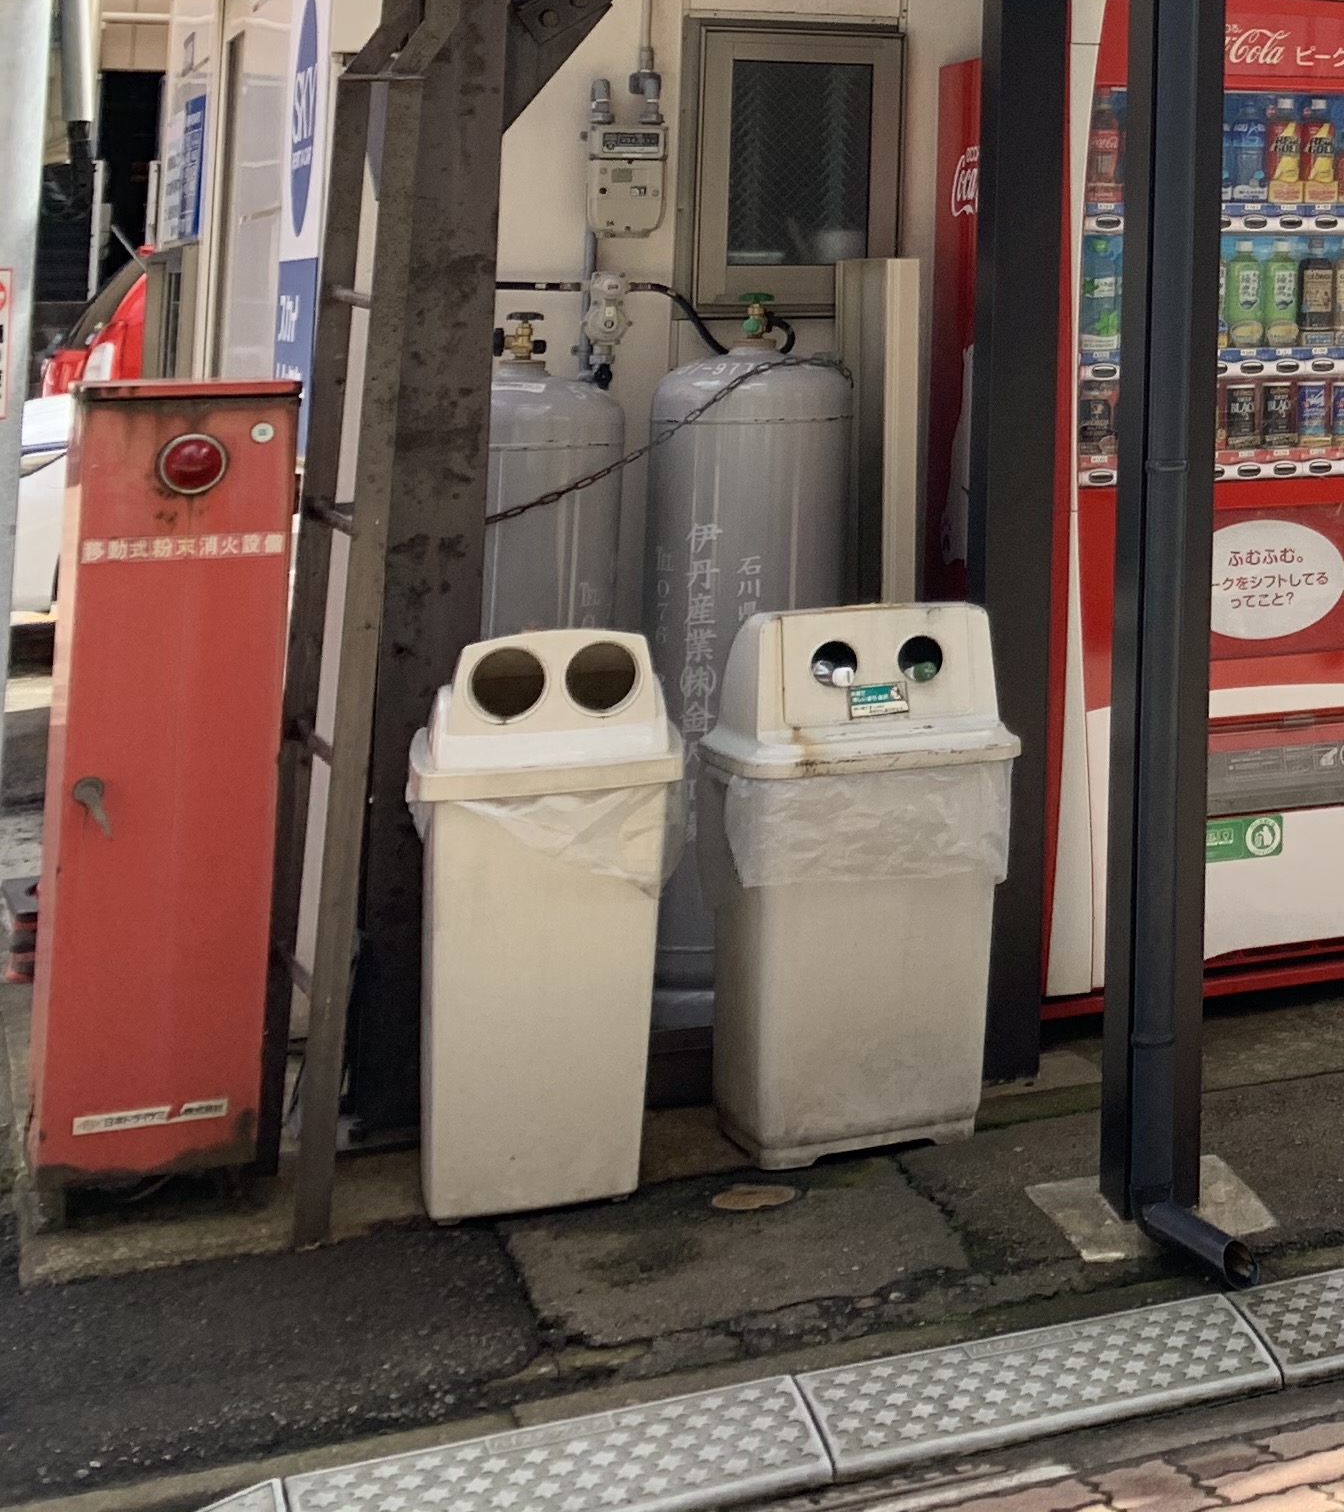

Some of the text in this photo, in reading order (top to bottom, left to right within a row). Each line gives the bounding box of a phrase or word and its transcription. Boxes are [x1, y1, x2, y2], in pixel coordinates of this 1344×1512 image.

[293, 64, 318, 144] SKY
[1228, 548, 1304, 567] ふむふむ。
[1231, 591, 1294, 609] ってこと?
